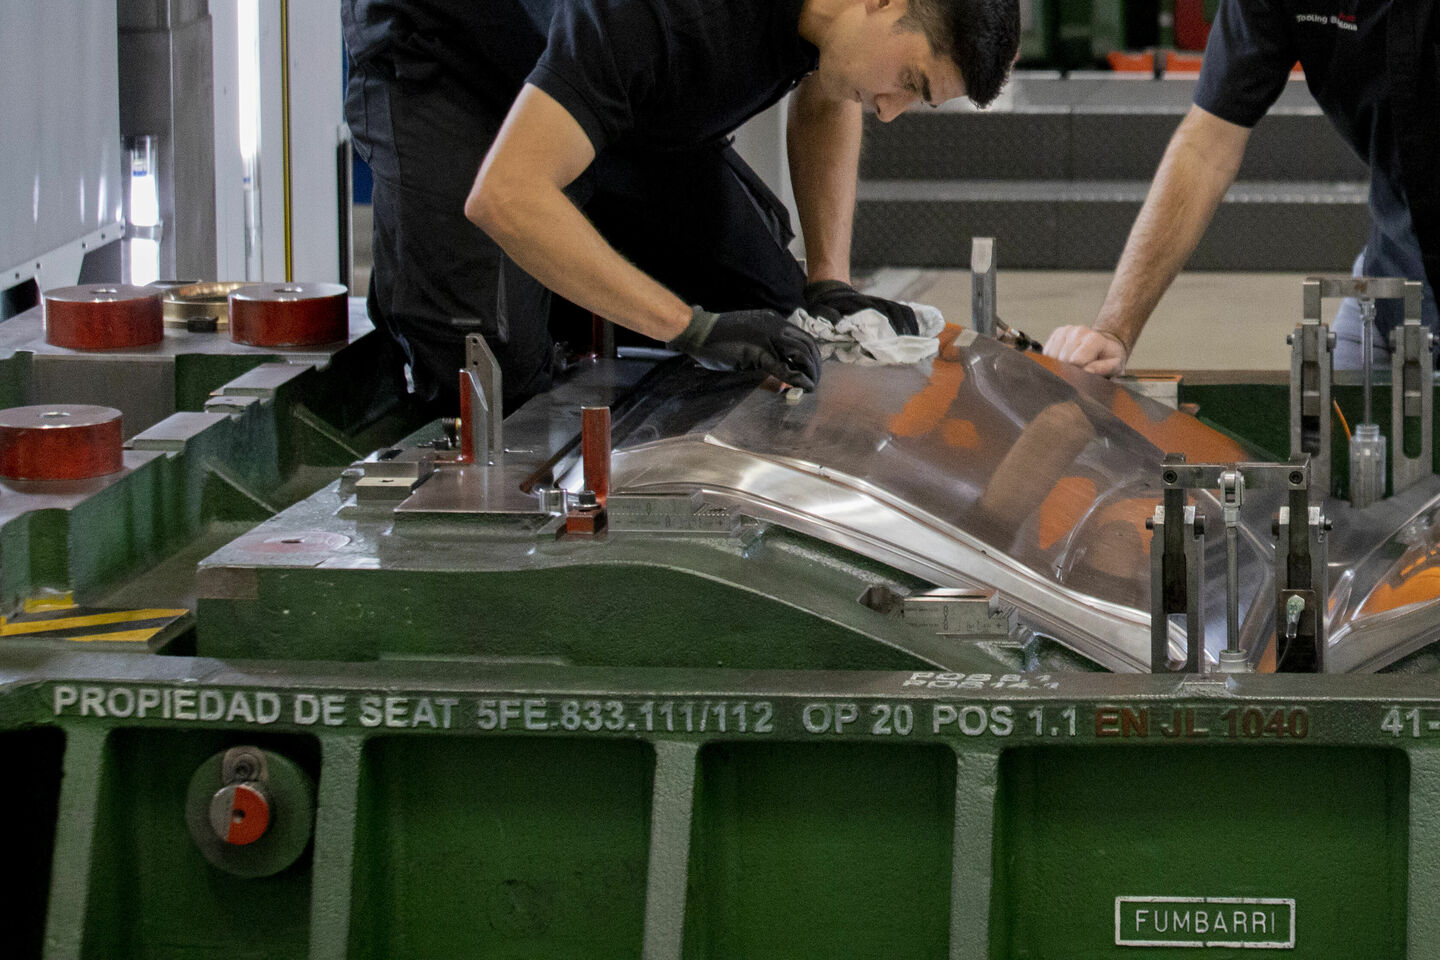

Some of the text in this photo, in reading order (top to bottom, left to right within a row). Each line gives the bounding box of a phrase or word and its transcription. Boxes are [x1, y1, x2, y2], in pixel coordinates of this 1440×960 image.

[53, 685, 1309, 739] PROPIEDAD DE SEAT 5FE.833.111/112 OP 20 POS 1.1 EN JL 1040
[1135, 909, 1276, 934] FUMBARRI
